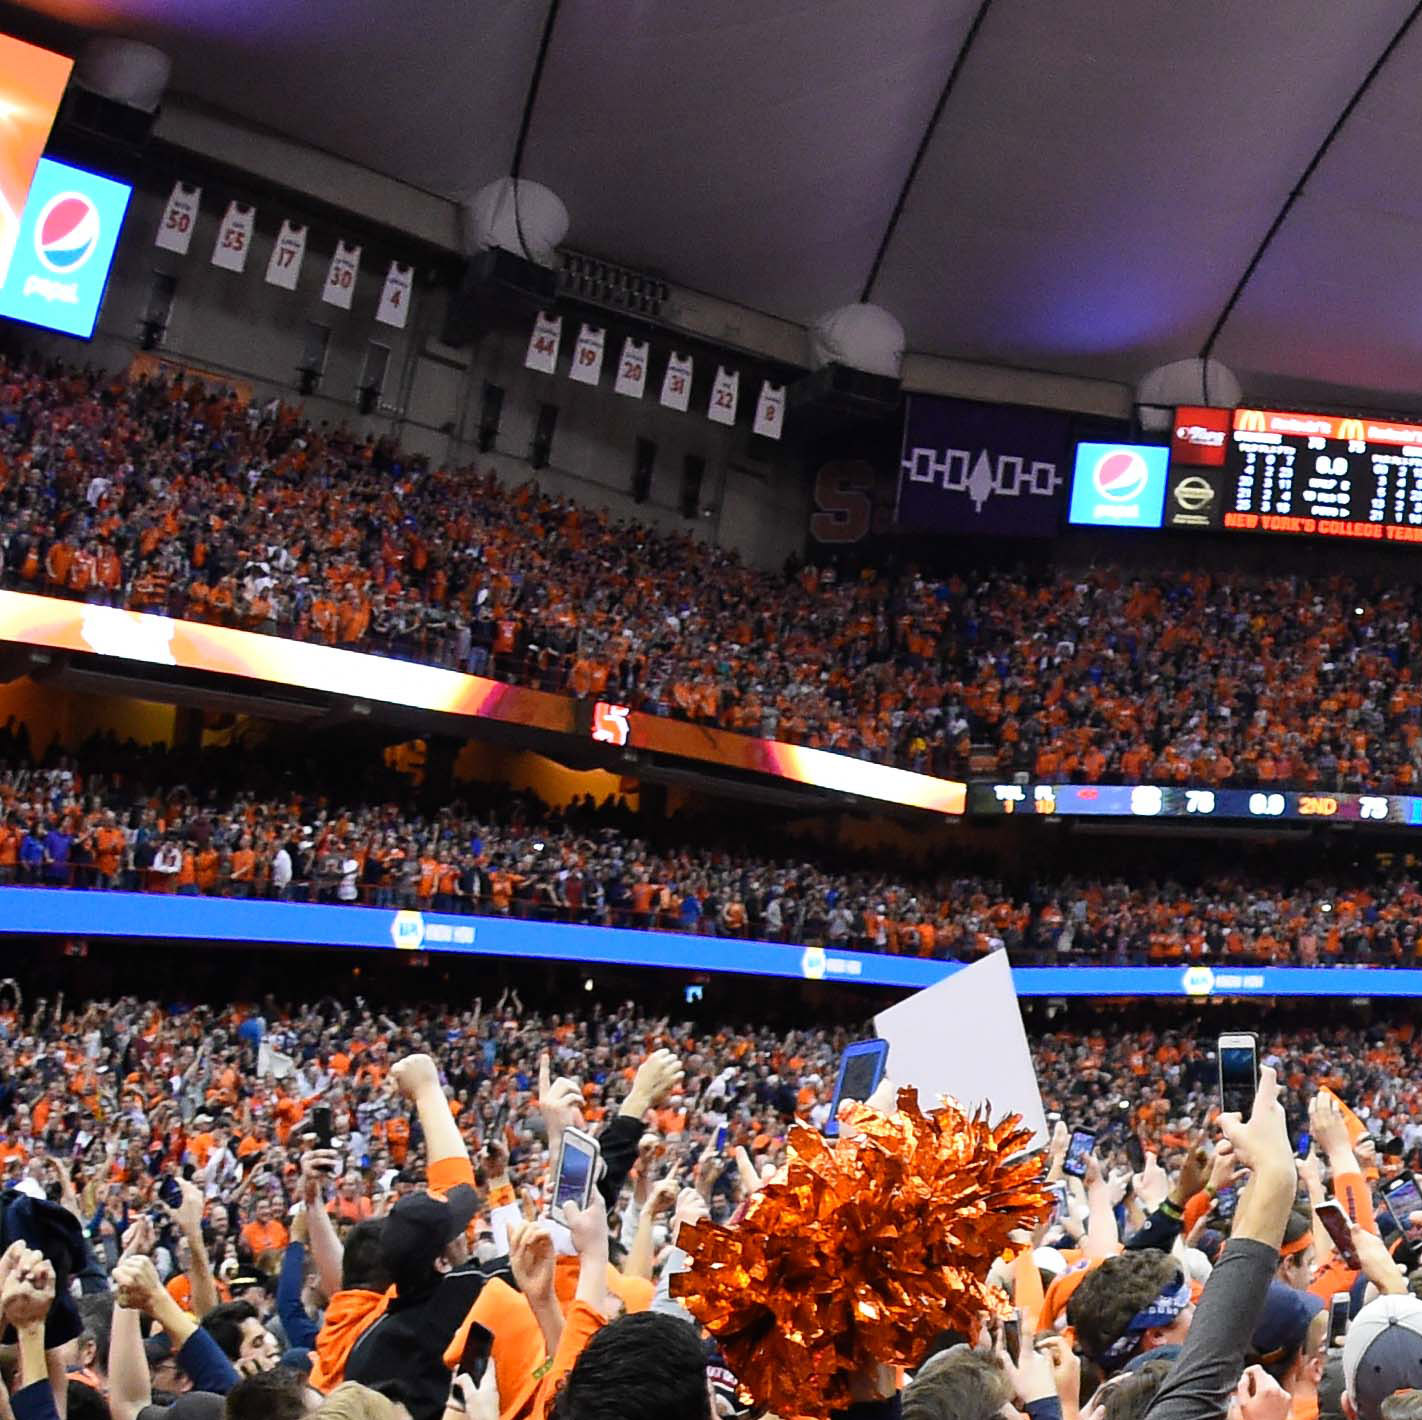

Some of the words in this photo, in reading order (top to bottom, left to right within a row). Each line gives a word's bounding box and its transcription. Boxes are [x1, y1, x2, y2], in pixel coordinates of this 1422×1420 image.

[166, 209, 191, 233] 50
[222, 228, 245, 251] 55
[276, 247, 297, 269] 17
[389, 289, 402, 309] 4
[579, 347, 595, 367] 19
[623, 361, 642, 382] 20
[714, 389, 733, 410] 22
[1225, 513, 1258, 528] NEW
[1318, 520, 1382, 538] COLLEGE
[1299, 797, 1337, 815] 2ND
